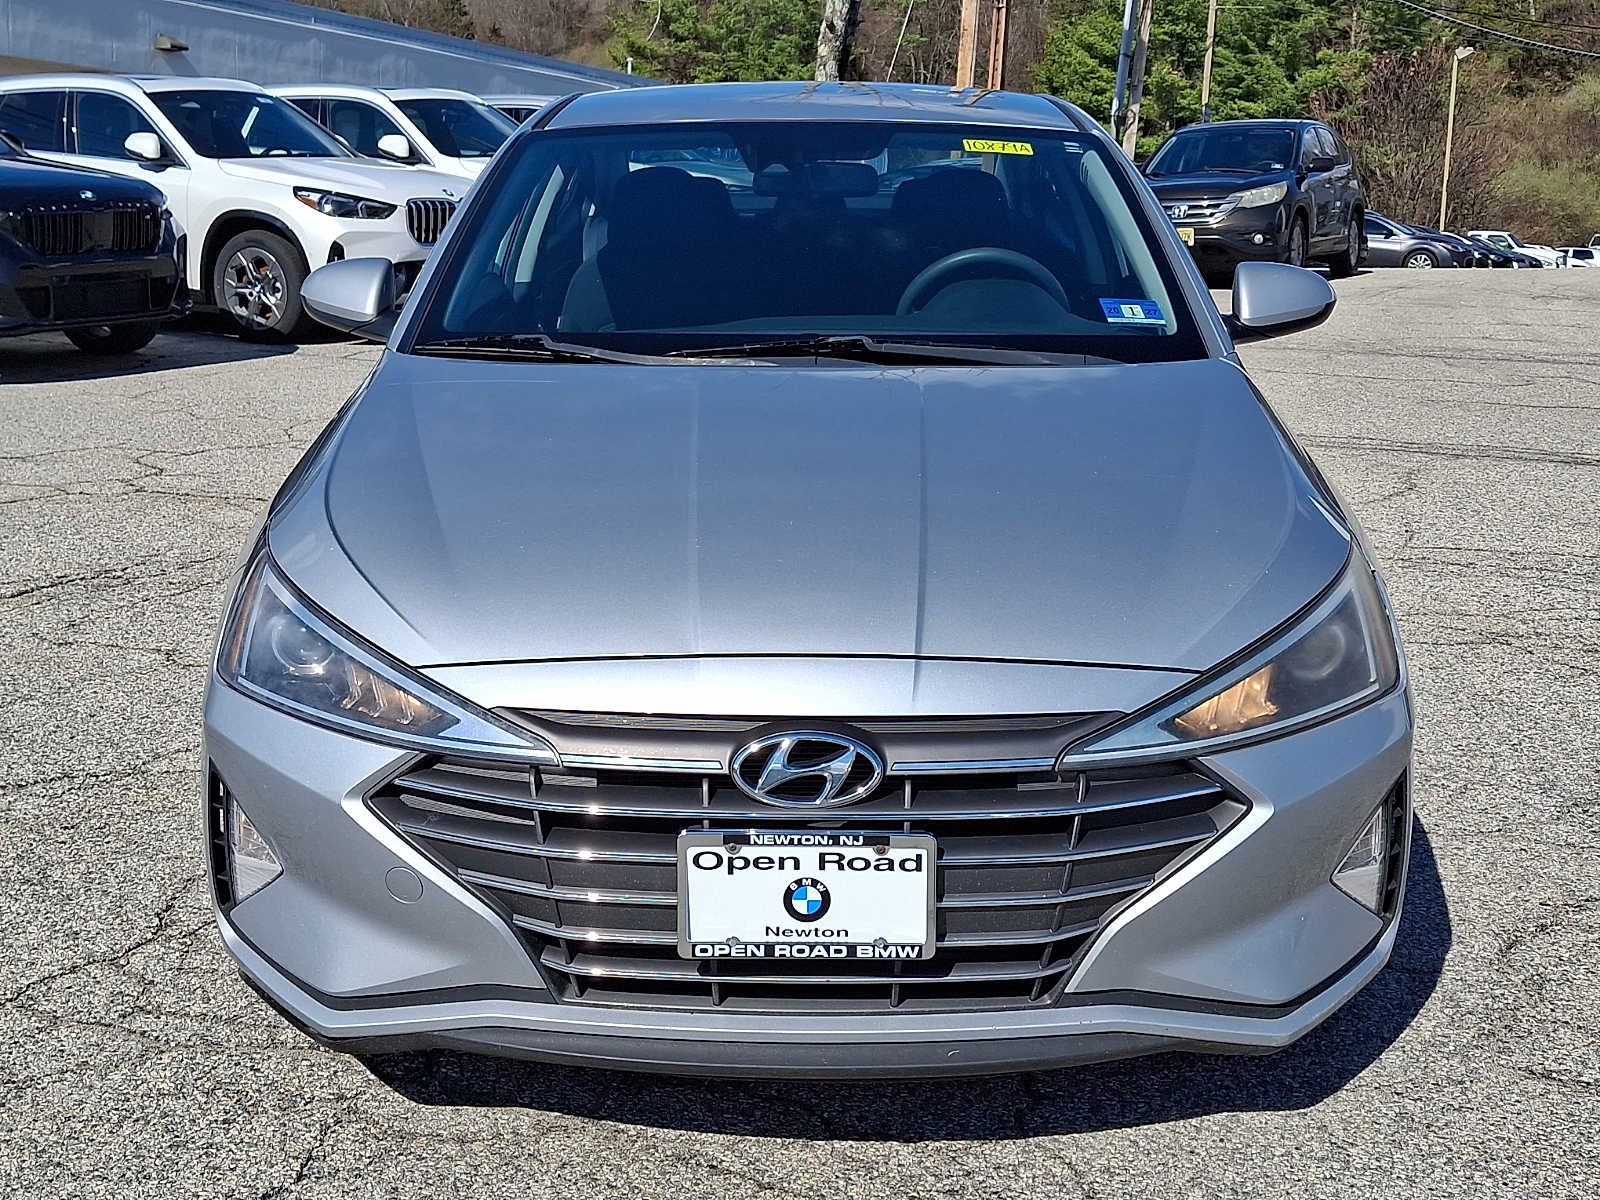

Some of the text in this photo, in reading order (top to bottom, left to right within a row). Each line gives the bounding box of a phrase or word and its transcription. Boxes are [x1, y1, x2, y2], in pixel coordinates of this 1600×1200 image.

[1129, 306, 1136, 316] 1
[750, 834, 864, 846] NEWTON, NJ
[692, 851, 923, 875] Open Road
[790, 878, 827, 892] BMW
[765, 926, 849, 938] Newton
[695, 944, 920, 958] OPEN ROAD BMW
